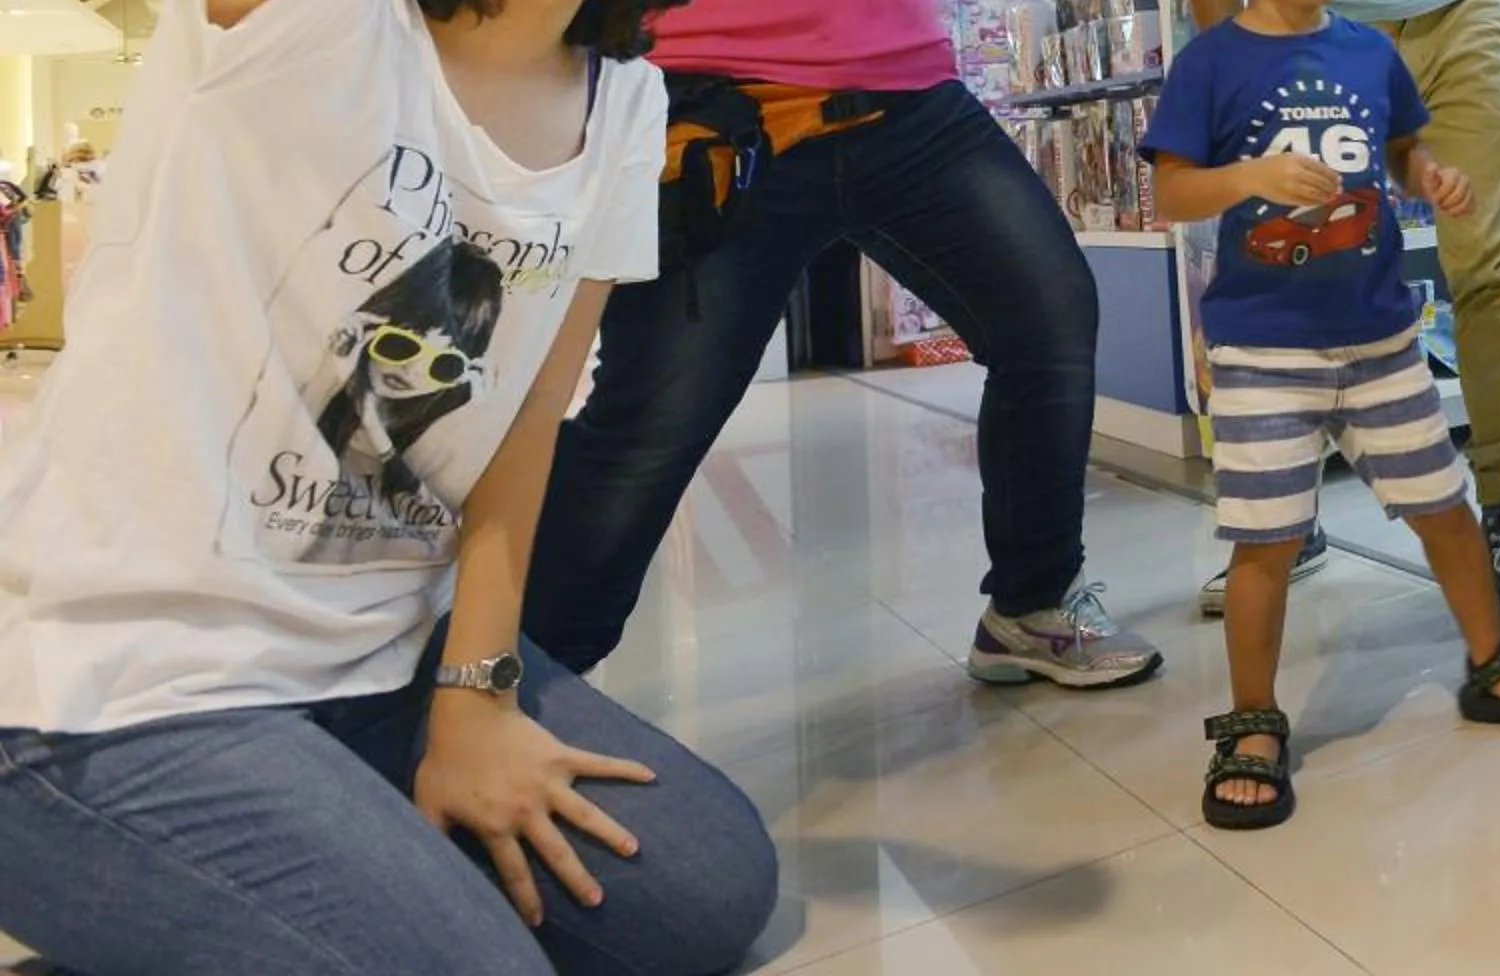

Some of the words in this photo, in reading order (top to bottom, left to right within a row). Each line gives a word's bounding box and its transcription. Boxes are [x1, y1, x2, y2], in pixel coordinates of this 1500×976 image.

[1279, 107, 1351, 121] TOMICA
[1262, 123, 1371, 174] 46
[338, 230, 427, 286] of
